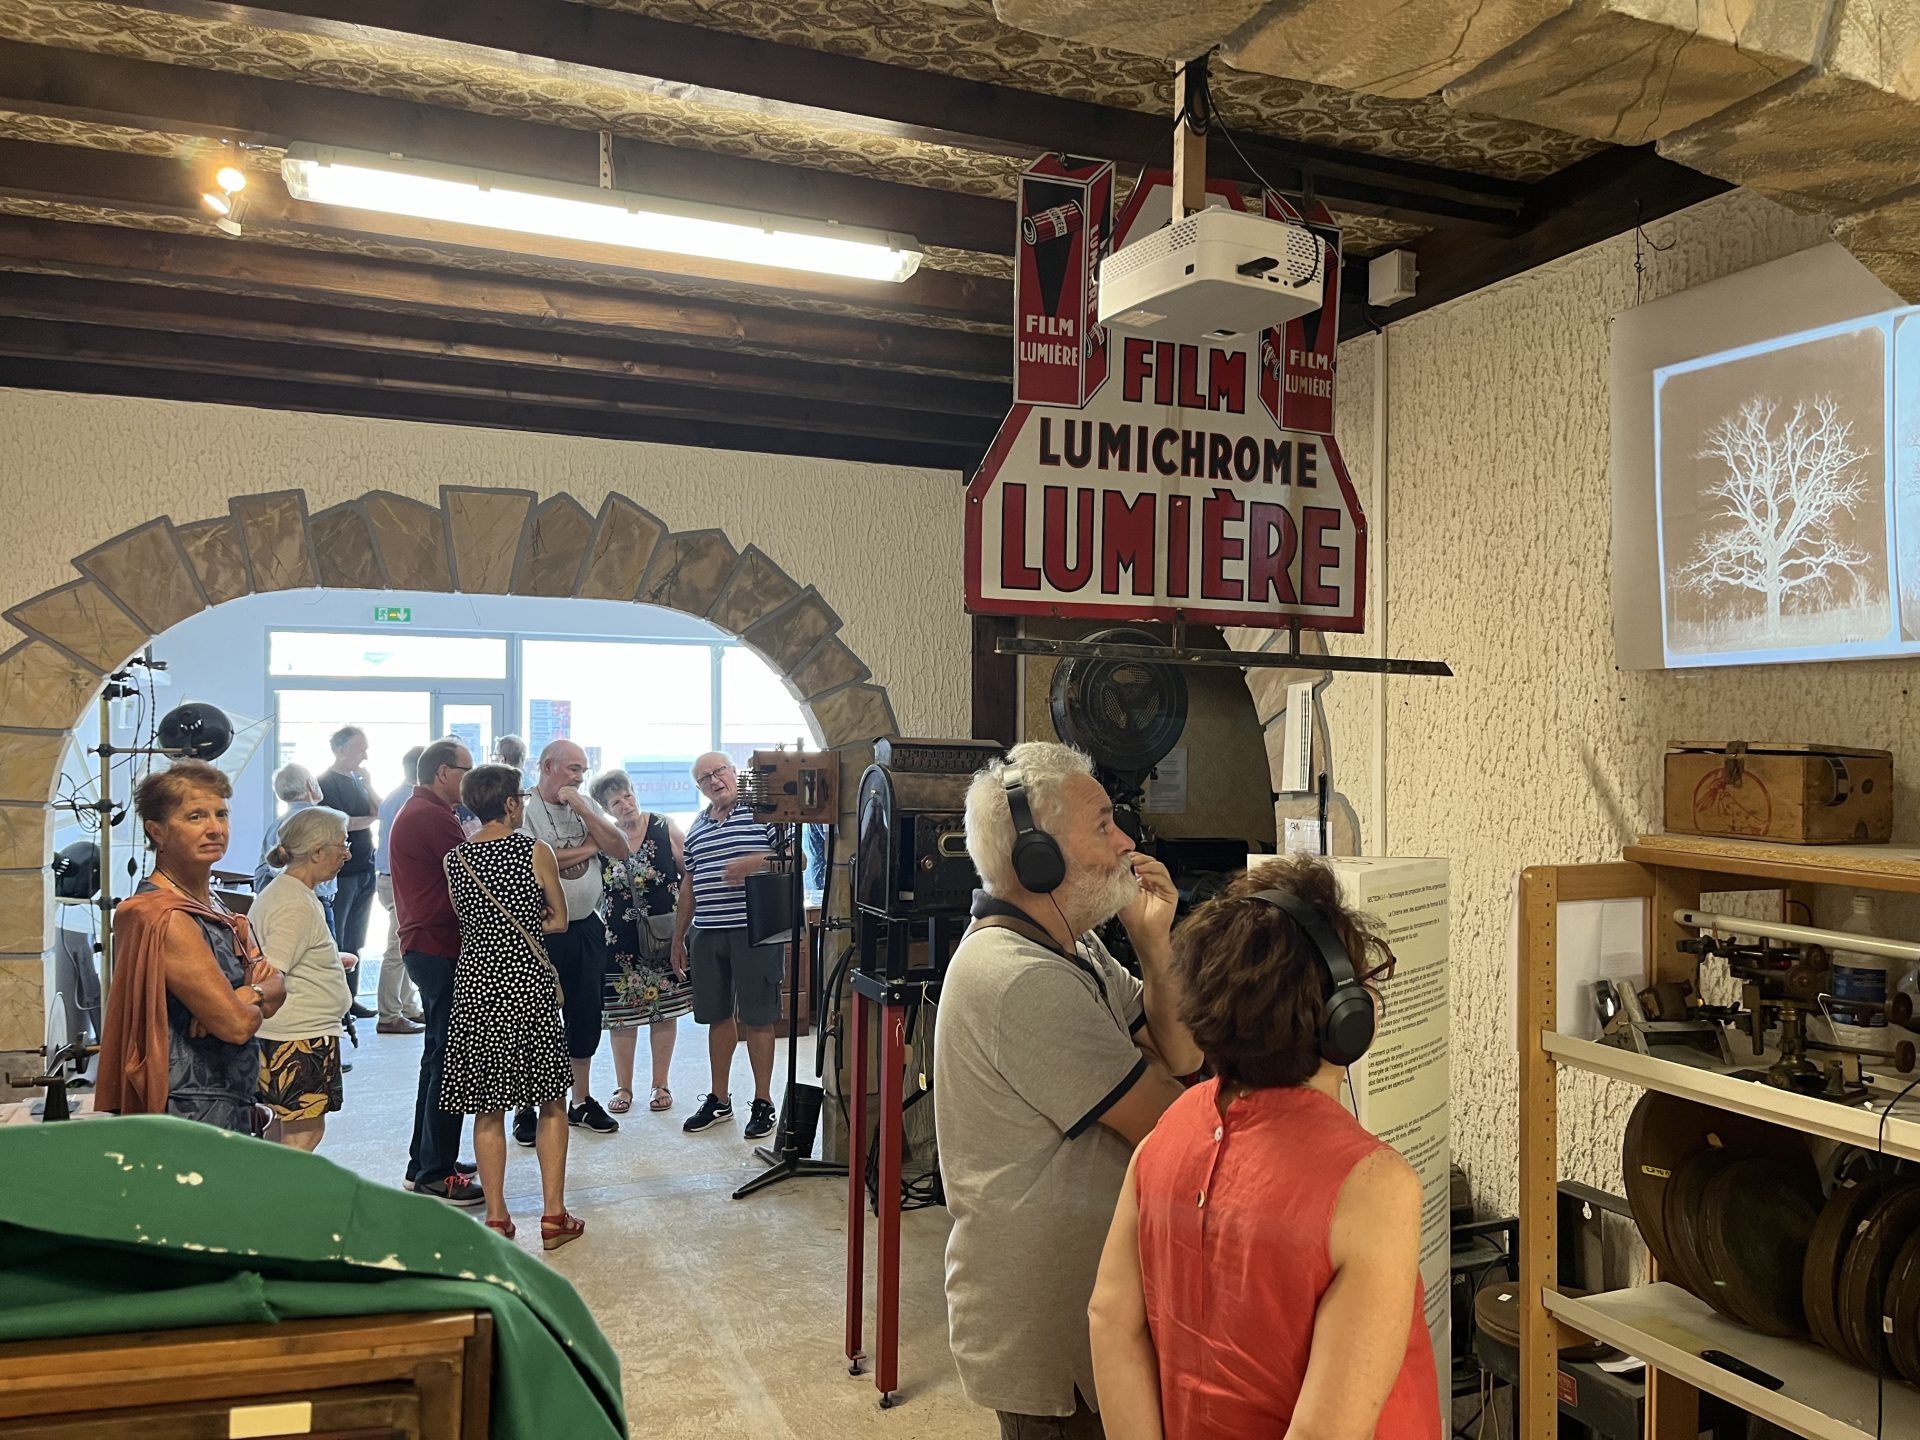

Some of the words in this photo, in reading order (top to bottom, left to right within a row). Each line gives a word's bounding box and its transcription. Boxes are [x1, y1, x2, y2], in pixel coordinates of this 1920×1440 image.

[1026, 314, 1074, 337] FILM
[1020, 341, 1079, 367] LUMIÈRE
[1289, 349, 1328, 370] FILM
[1122, 338, 1247, 414] FILM
[1285, 374, 1331, 398] LUMIÈRE
[1039, 417, 1318, 488] LUMICHROME
[1000, 482, 1341, 606] LUMIÈRE
[1368, 1049, 1385, 1059] Comment
